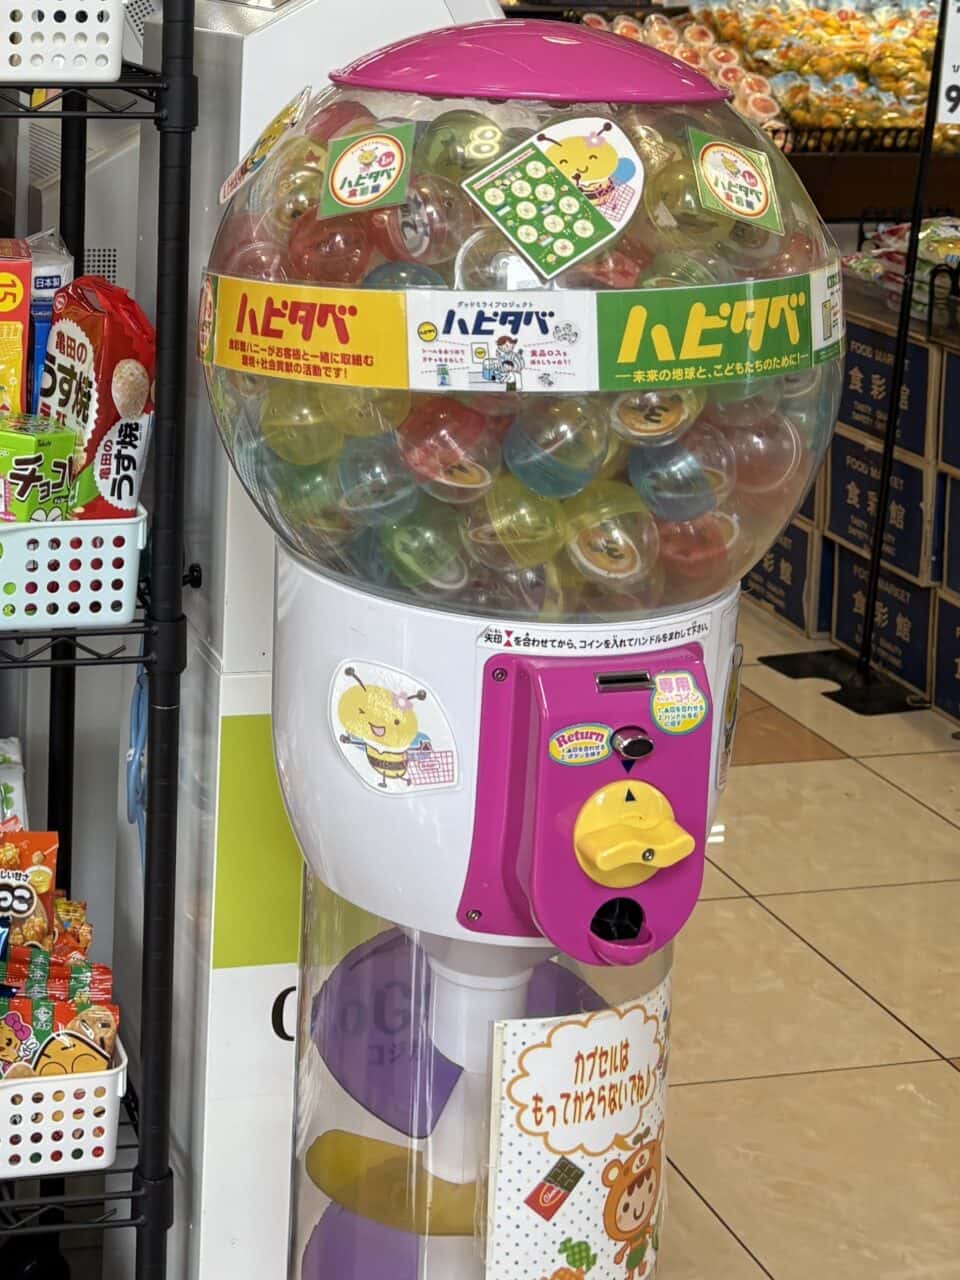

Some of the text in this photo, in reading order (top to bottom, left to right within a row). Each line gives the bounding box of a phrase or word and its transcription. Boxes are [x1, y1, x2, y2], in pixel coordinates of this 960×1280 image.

[35, 275, 61, 290] 日本製
[235, 292, 358, 345] ハピタベ
[619, 291, 806, 365] ハピタベ
[55, 330, 88, 364] 亀田の
[555, 729, 605, 748] Return
